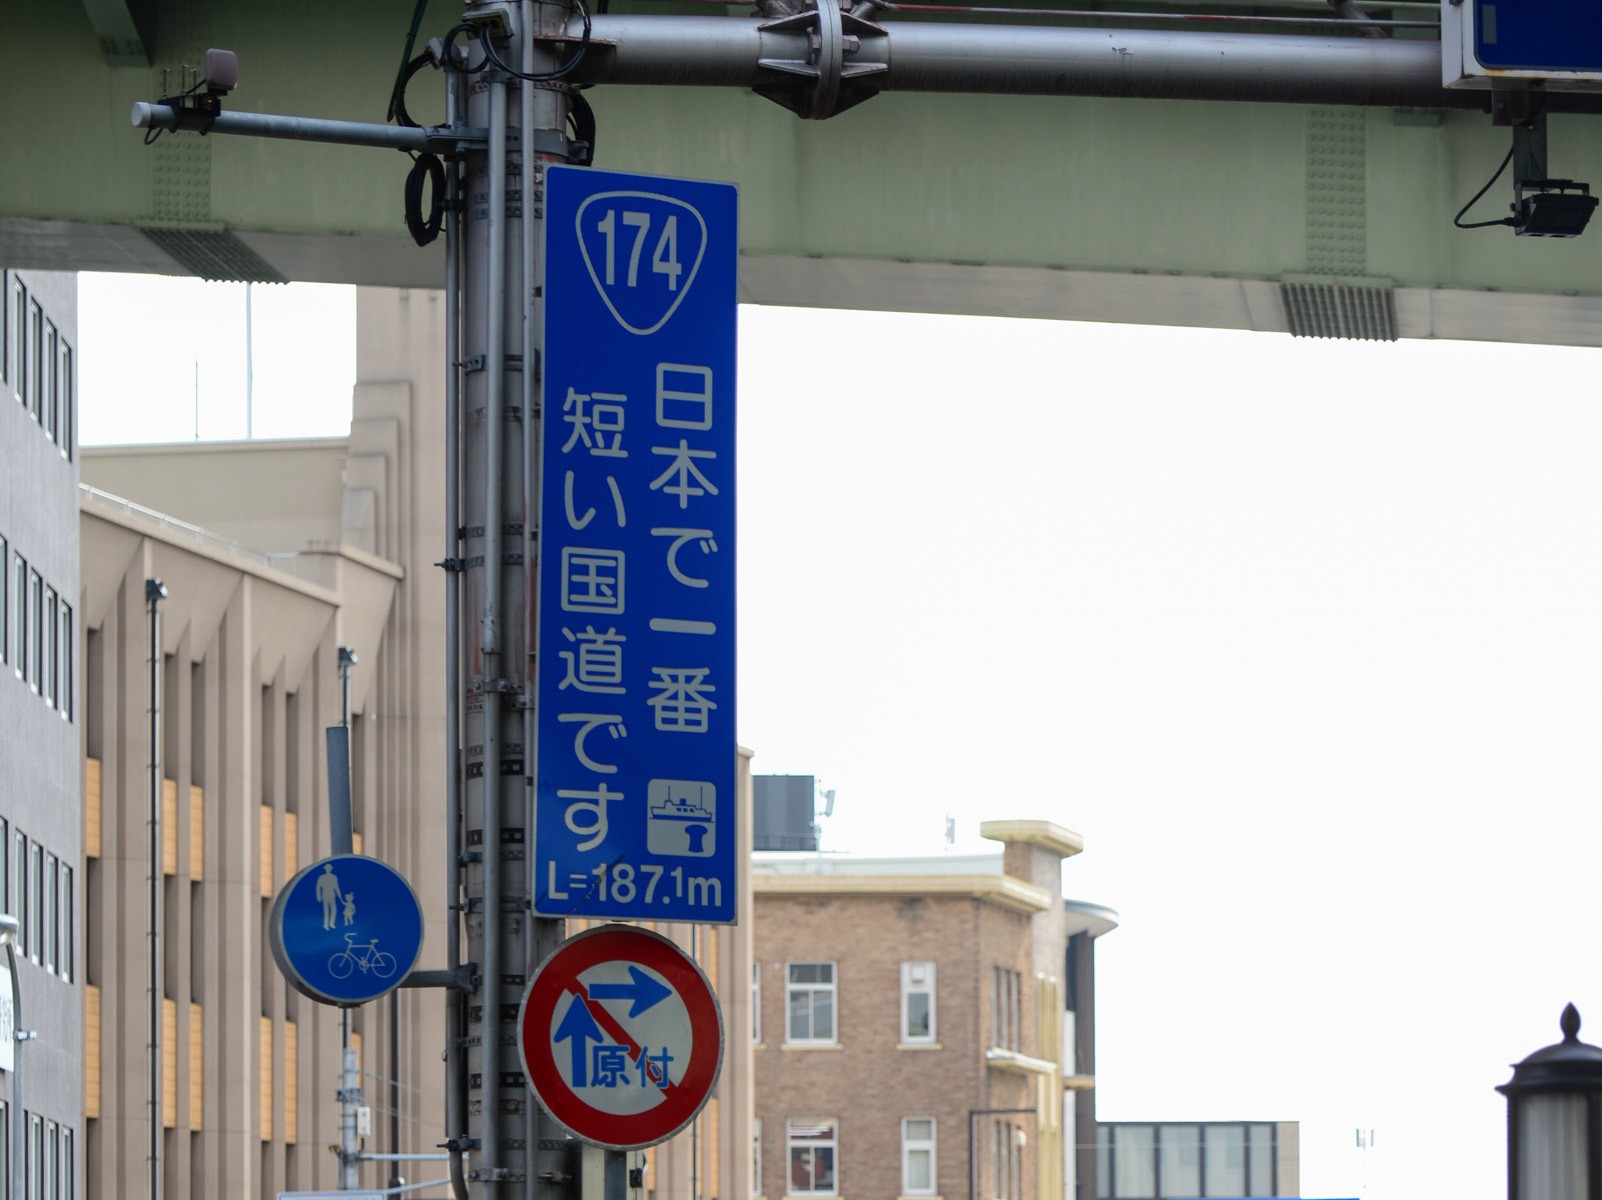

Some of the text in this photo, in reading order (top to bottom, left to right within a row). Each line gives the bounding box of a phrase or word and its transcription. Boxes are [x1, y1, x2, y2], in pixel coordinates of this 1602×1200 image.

[597, 209, 684, 292] 174
[646, 361, 720, 734] 日本で一番
[556, 385, 629, 854] 短い国道です
[548, 860, 723, 908] L=187.1m
[590, 1045, 675, 1090] 原付
